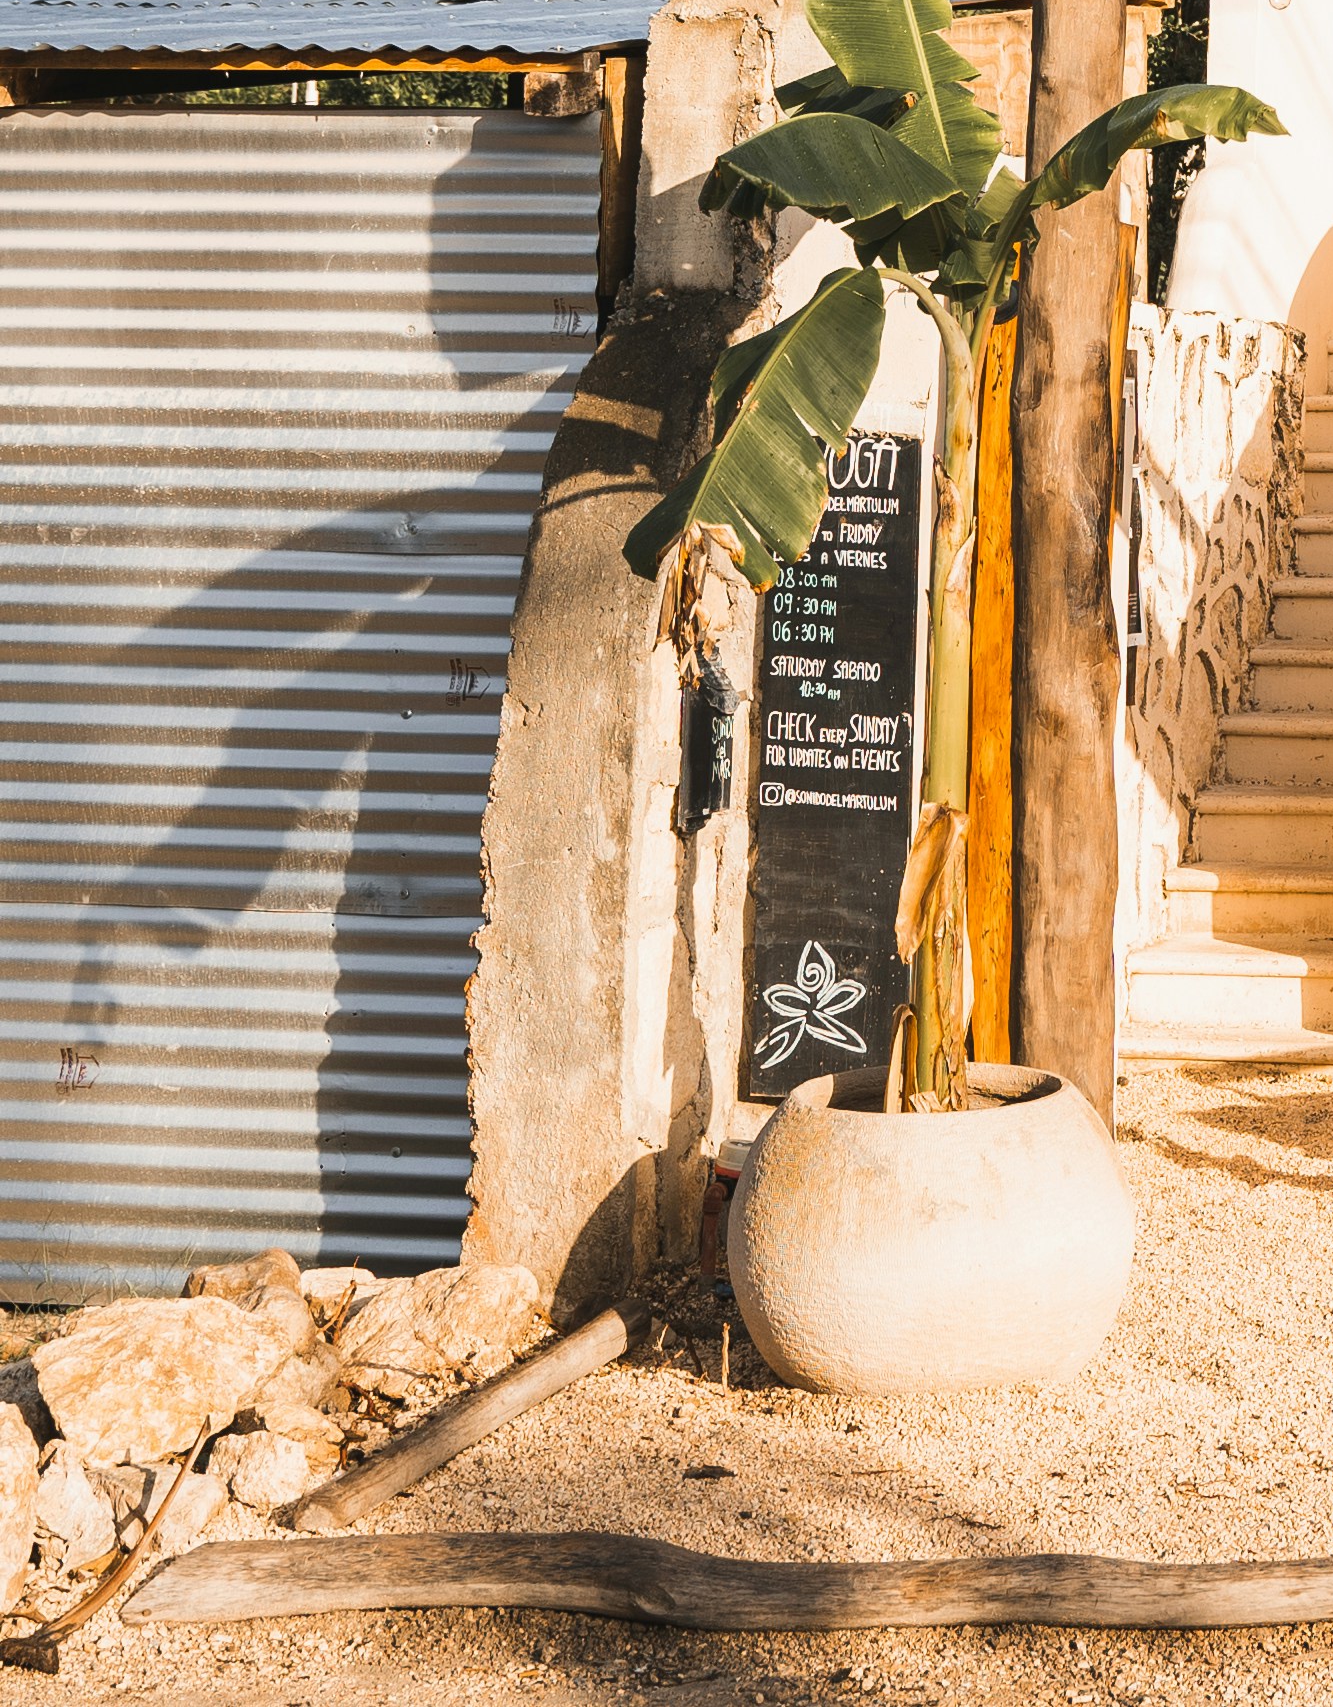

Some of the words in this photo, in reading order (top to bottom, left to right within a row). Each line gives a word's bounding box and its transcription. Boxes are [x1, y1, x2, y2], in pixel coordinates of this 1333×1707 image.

[824, 437, 901, 490] OGA
[827, 495, 899, 515] DELMARTULUM
[821, 530, 833, 541] TO
[840, 522, 883, 546] FRIDAY
[820, 552, 828, 565] A
[834, 550, 887, 569] VIERNES
[821, 574, 837, 588] AM
[774, 593, 818, 614] 09:30
[821, 600, 836, 616] AM
[772, 621, 816, 642] 06:30
[820, 626, 834, 644] PM
[770, 655, 826, 678] SATURDAY
[833, 659, 881, 682] SABADO
[799, 680, 826, 697] 10:30
[828, 689, 840, 700] AM
[767, 711, 816, 742] CHECK
[819, 728, 847, 748] EVERY
[849, 714, 899, 745] SUNDAY
[765, 744, 786, 766] FOR
[789, 746, 832, 769] UPDATES
[852, 748, 902, 772] EVENTS
[785, 788, 897, 811] @SONIDODELMARTULUM
